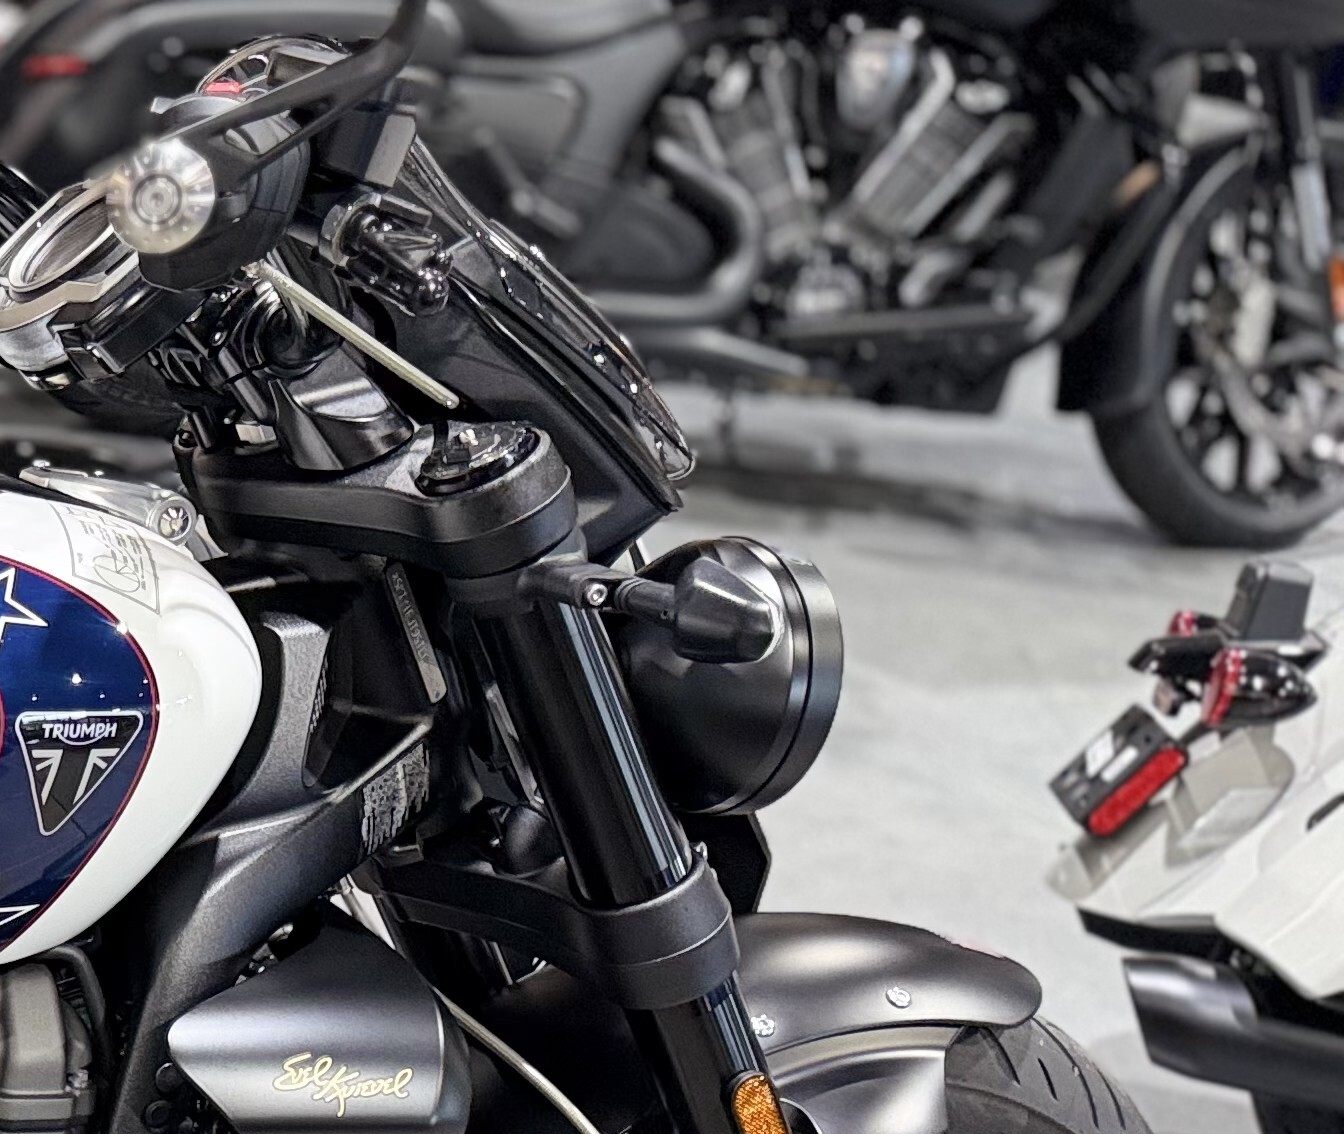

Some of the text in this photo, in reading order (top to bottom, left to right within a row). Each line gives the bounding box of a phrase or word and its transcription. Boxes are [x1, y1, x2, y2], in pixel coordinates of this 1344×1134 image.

[41, 722, 118, 745] TRIUMPH
[273, 1052, 413, 1117] Evel Knievel
